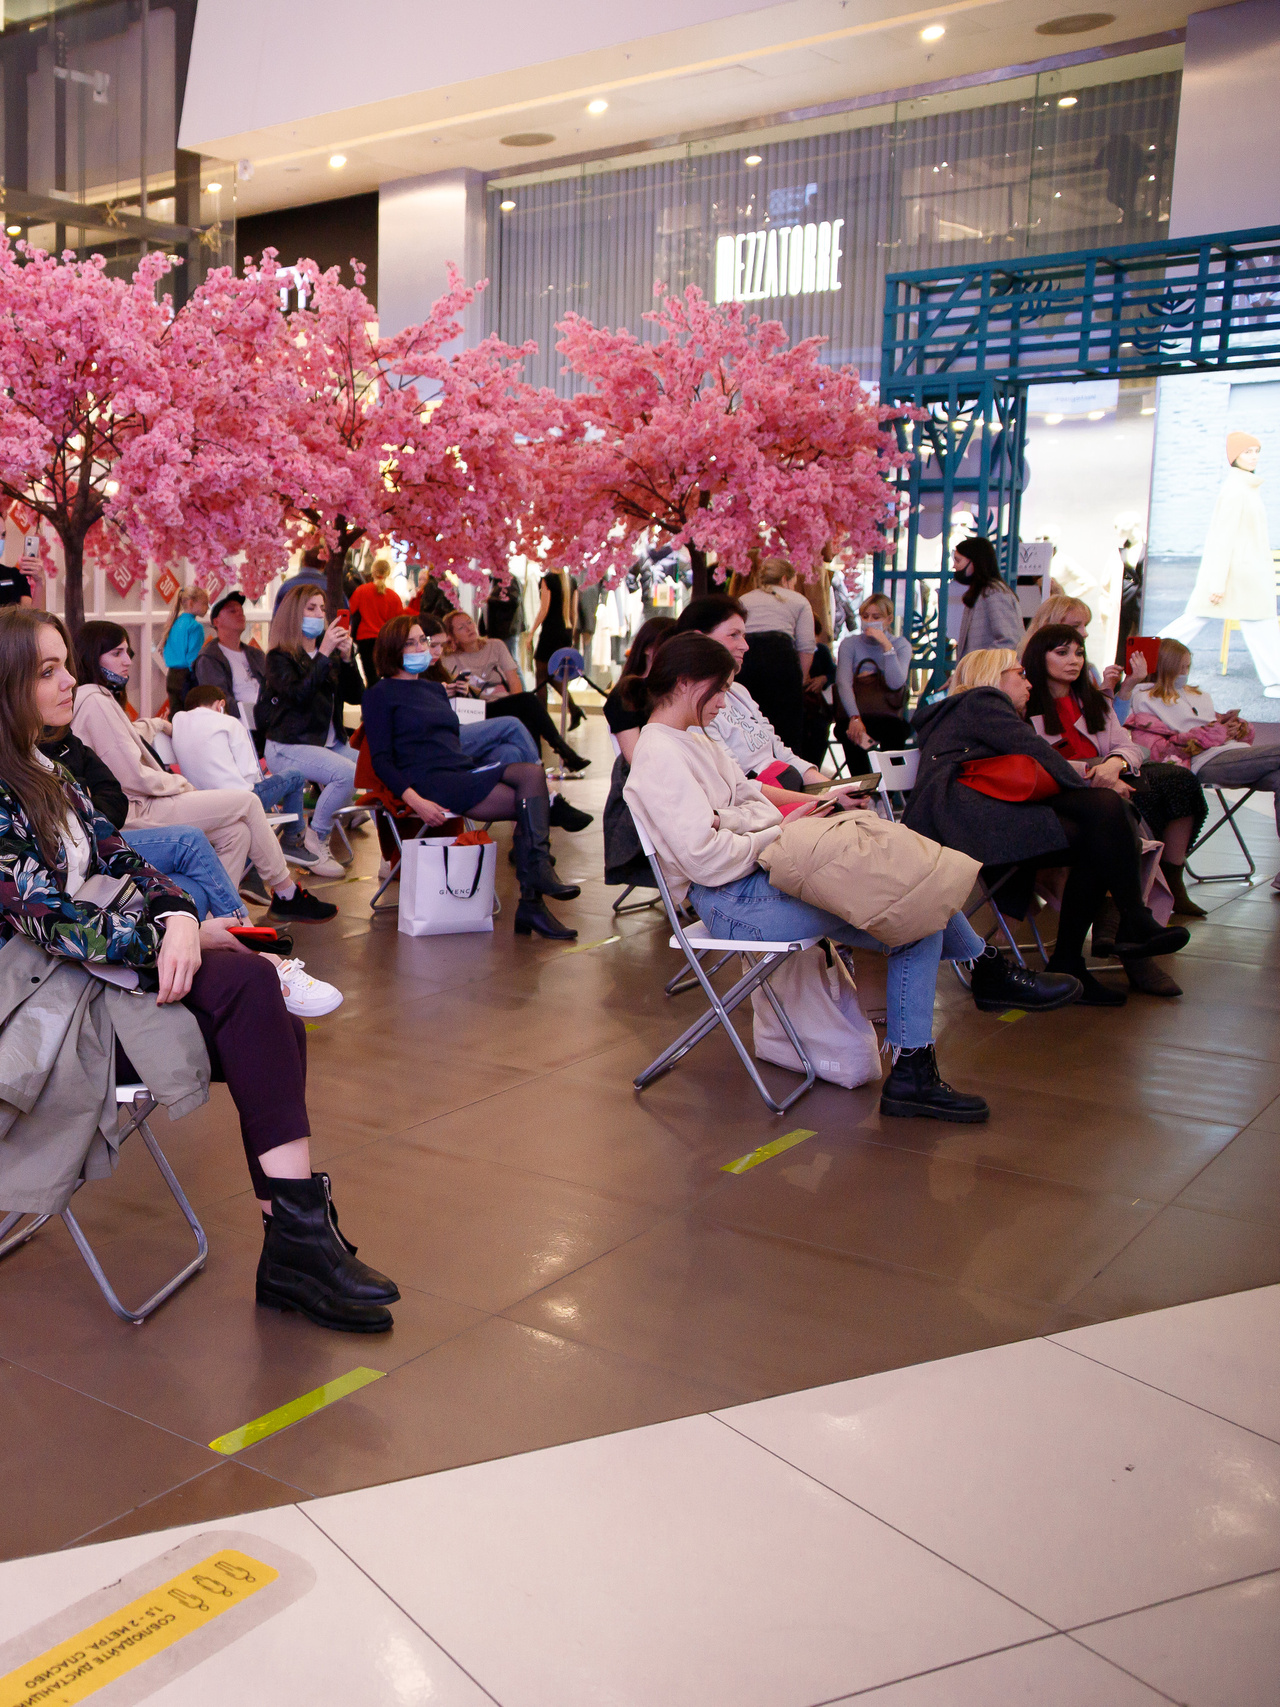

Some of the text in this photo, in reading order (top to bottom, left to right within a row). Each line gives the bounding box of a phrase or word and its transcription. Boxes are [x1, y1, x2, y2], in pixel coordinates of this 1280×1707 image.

[716, 218, 845, 304] MEZZATORRE
[128, 1620, 139, 1628] 2
[145, 1606, 163, 1617] 1,5
[92, 1613, 176, 1664] СОБЛЮДАЙТЕ
[25, 1651, 86, 1689] СПАСИБО
